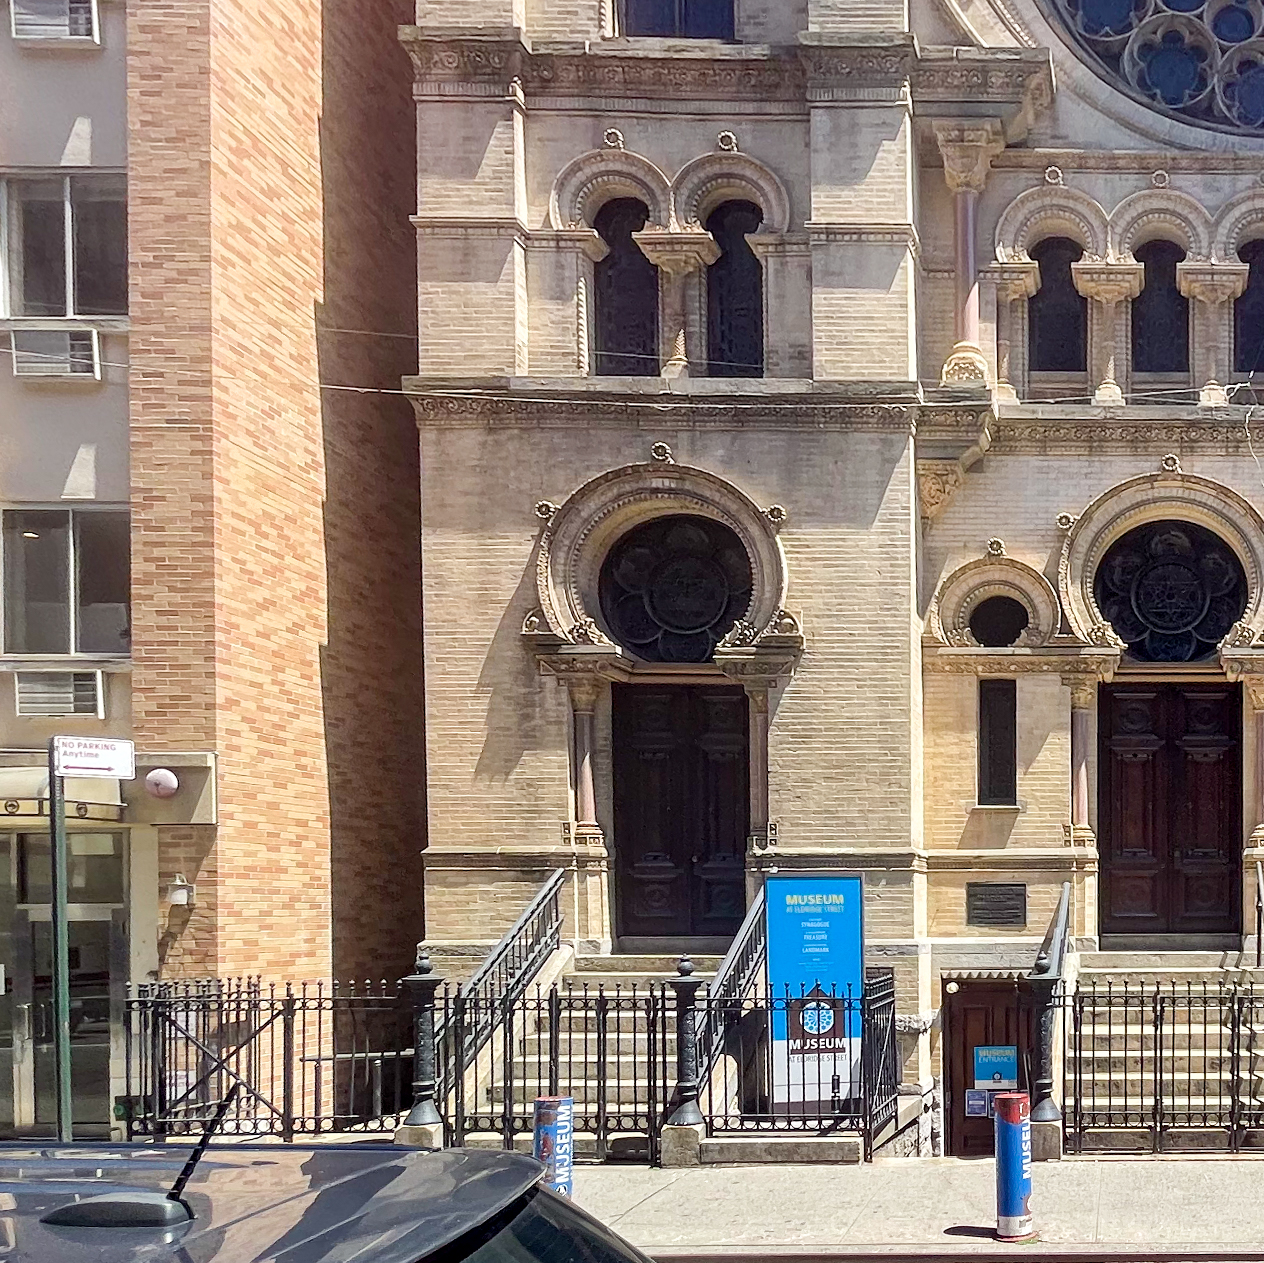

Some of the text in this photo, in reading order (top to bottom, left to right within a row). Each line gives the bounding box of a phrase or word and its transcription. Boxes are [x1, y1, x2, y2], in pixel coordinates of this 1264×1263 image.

[77, 742, 116, 750] PARKING
[62, 750, 99, 758] Anytime
[785, 894, 844, 905] MUSEUM
[789, 1038, 846, 1050] MUSEUM
[797, 1055, 825, 1063] EDRIDE
[826, 1054, 847, 1062] STEET
[556, 1105, 571, 1183] MUSEUM
[1020, 1102, 1032, 1179] MUSEU
